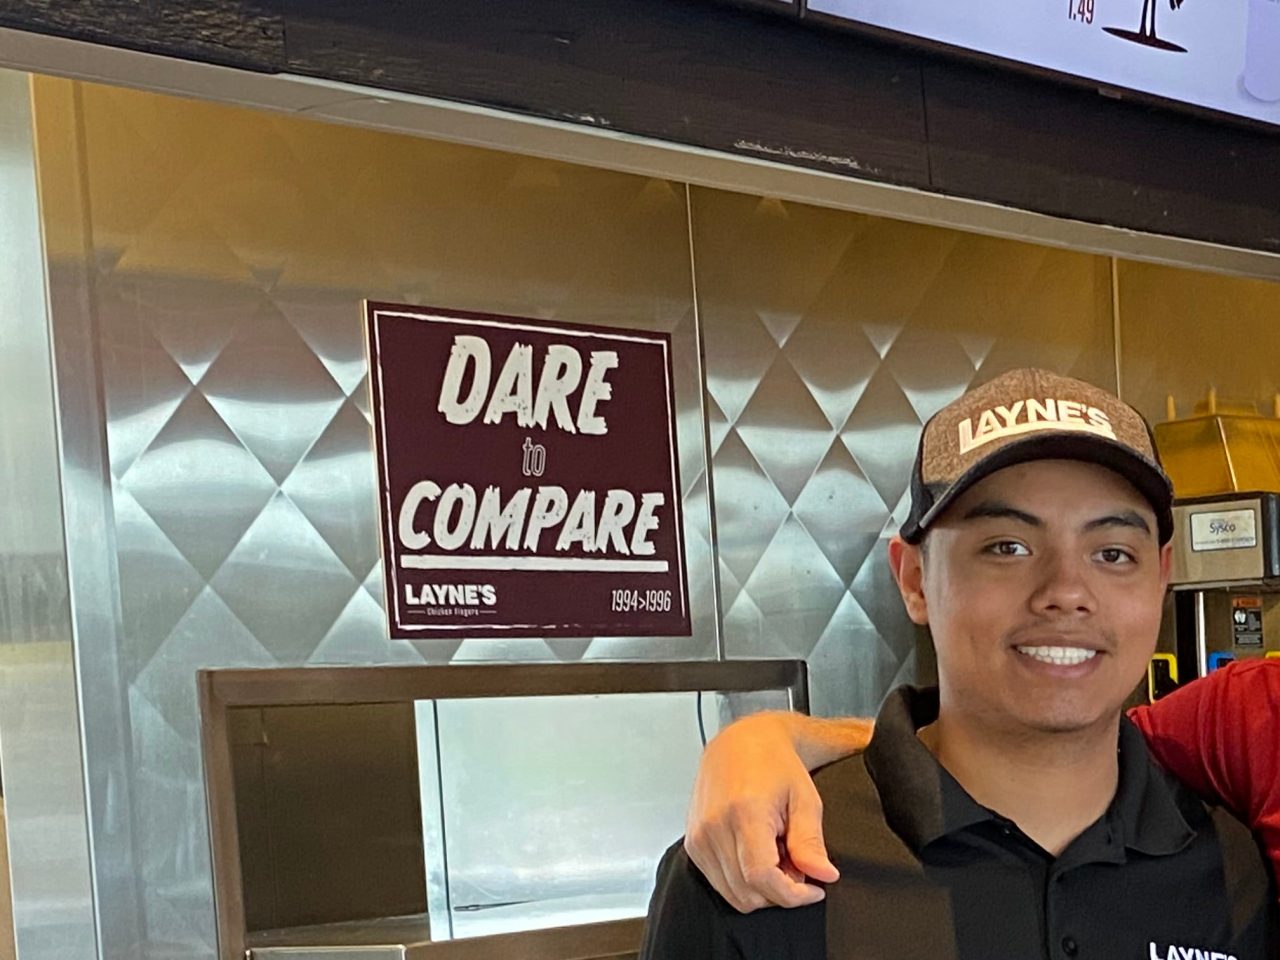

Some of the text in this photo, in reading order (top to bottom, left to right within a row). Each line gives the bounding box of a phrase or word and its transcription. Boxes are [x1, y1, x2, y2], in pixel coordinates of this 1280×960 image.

[438, 334, 619, 435] DARE
[958, 398, 1115, 456] LAYNE'S
[522, 437, 547, 477] to
[399, 480, 665, 556] COMPARE
[405, 584, 497, 606] LAYNE'S
